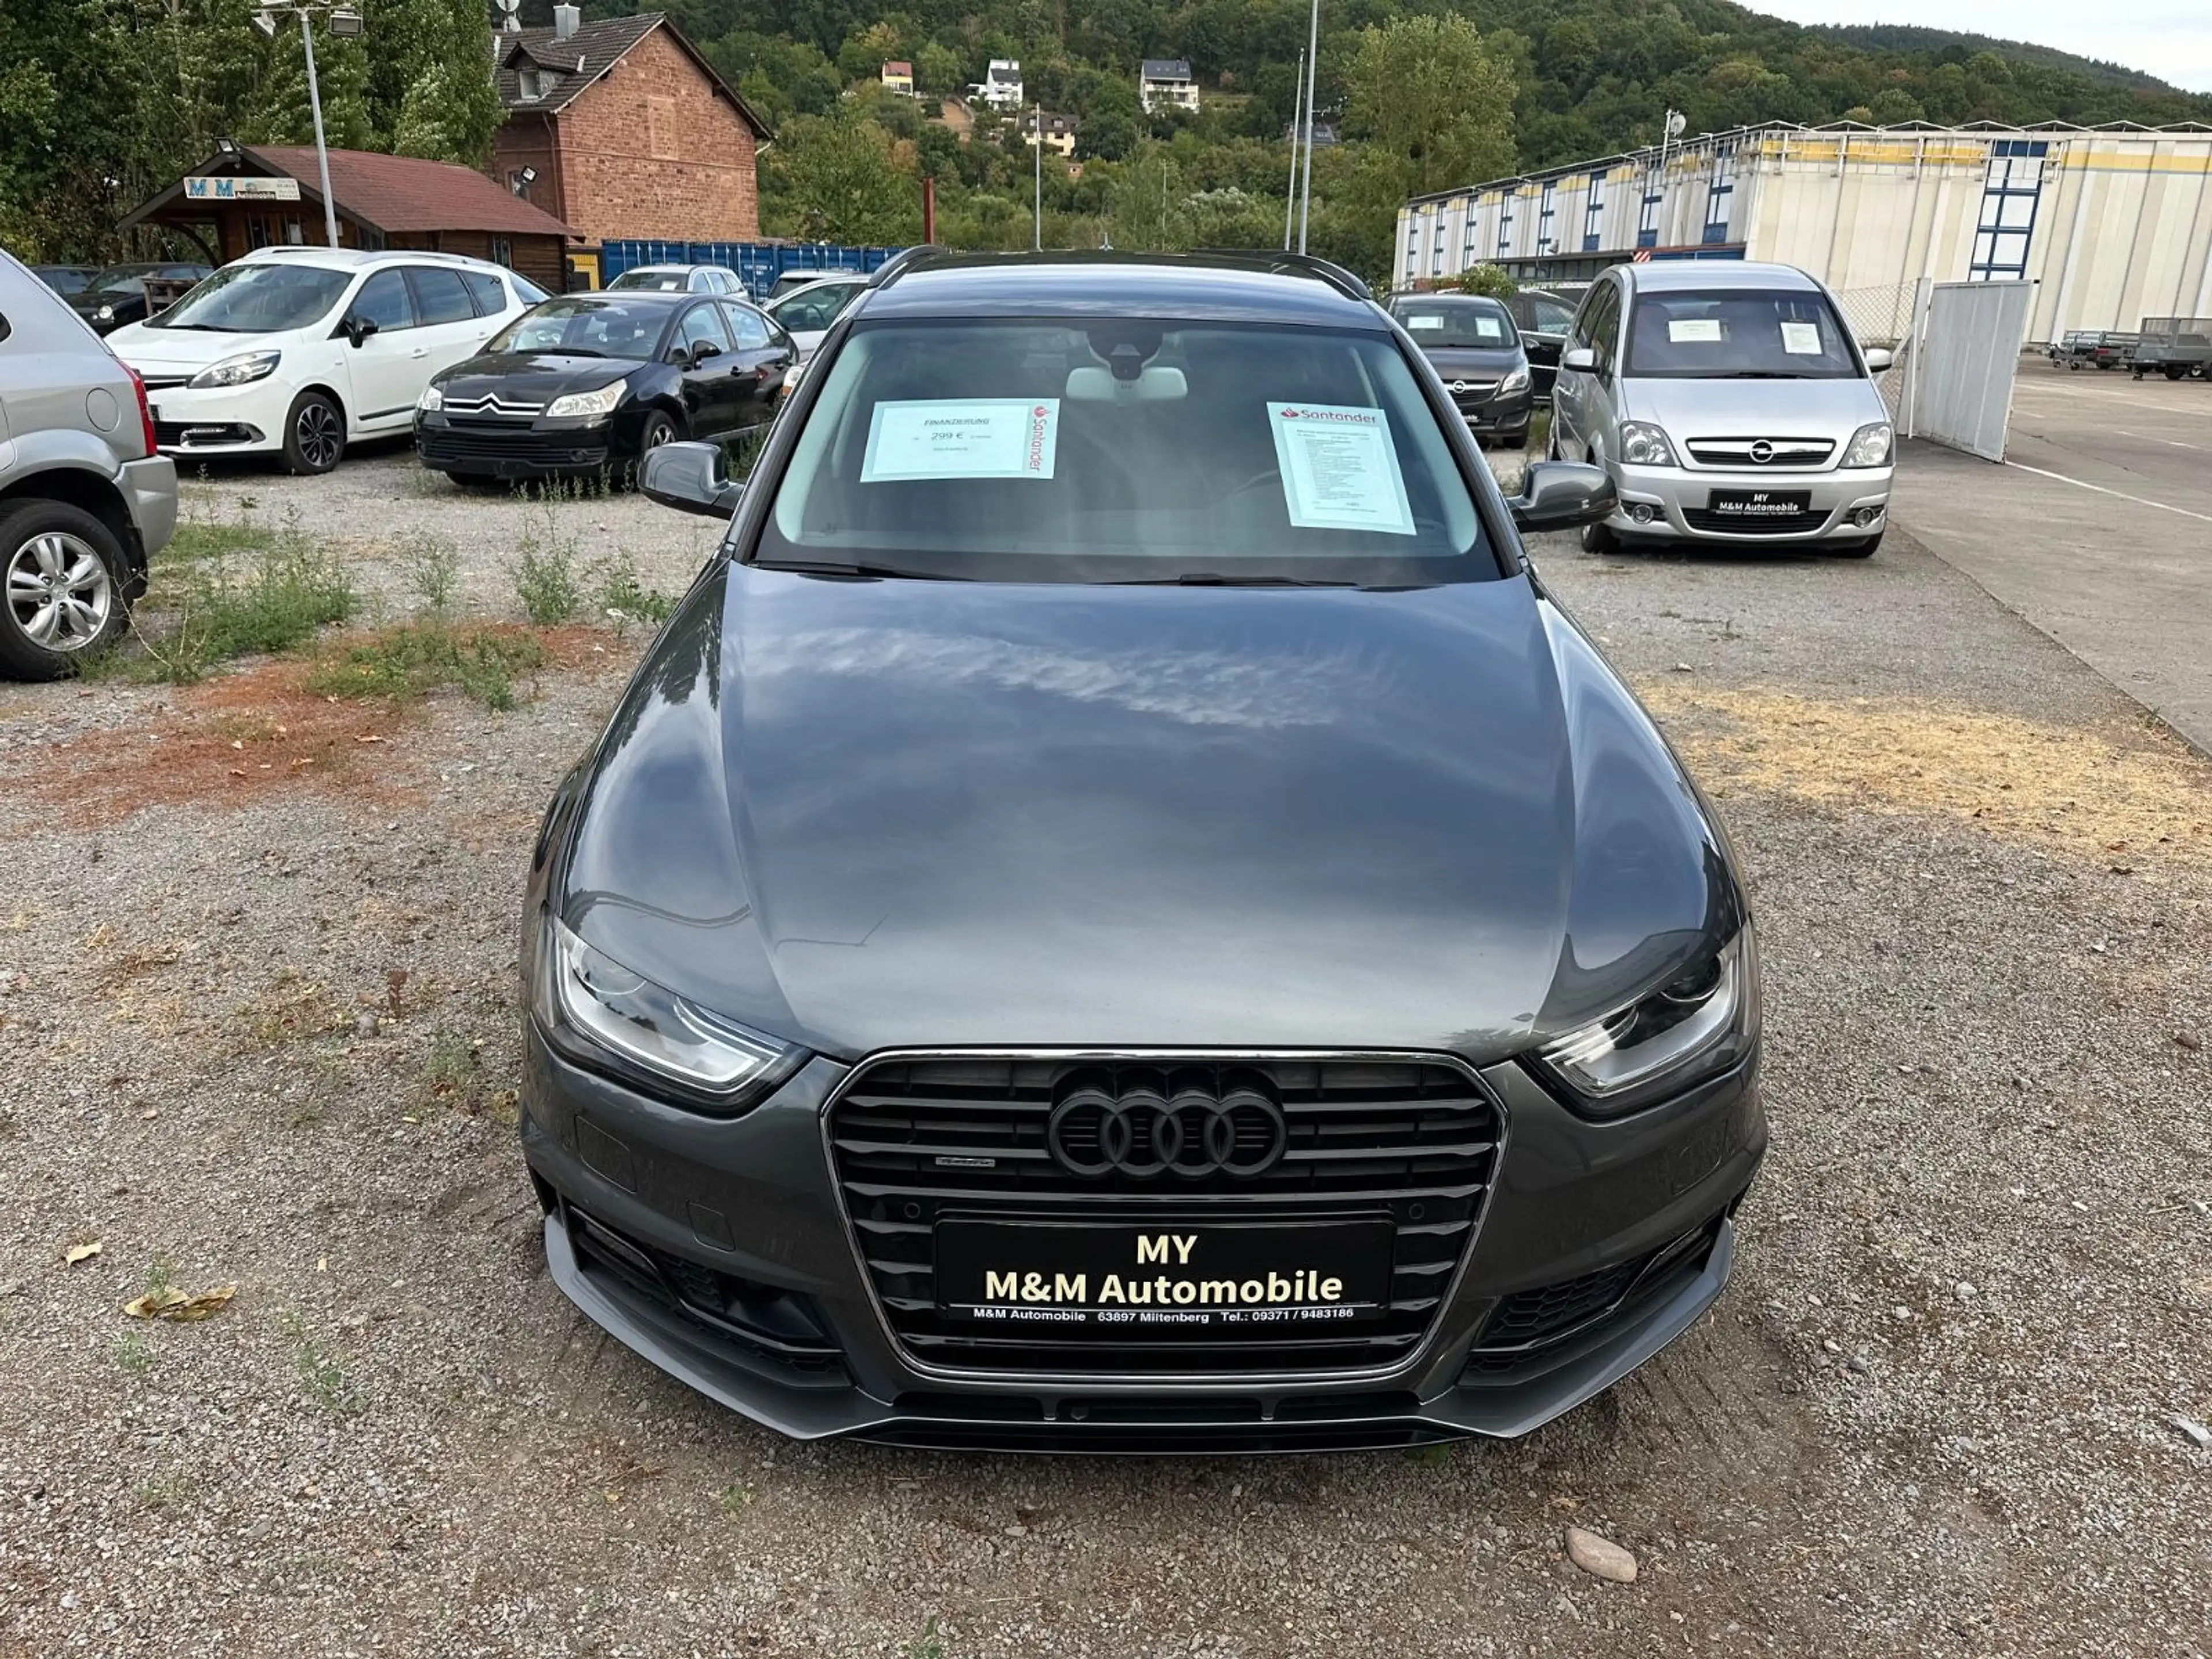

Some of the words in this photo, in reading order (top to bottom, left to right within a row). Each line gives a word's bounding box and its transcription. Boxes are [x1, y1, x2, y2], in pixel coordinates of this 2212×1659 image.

[1301, 410, 1376, 423] Santander
[1030, 419, 1047, 471] Santander
[1753, 494, 1768, 502] MY
[1719, 502, 1743, 510] M&M
[1745, 503, 1798, 511] Automobile
[1137, 1235, 1198, 1264] MY
[986, 1271, 1086, 1302] M&M
[1098, 1270, 1343, 1304] Automobile
[974, 1309, 1006, 1319] M&M
[1010, 1310, 1086, 1321] Automobile
[1097, 1313, 1135, 1321] 63897
[1140, 1313, 1209, 1324] Miltenberg
[1221, 1312, 1248, 1321] Tel.:
[1252, 1312, 1289, 1321] 09371
